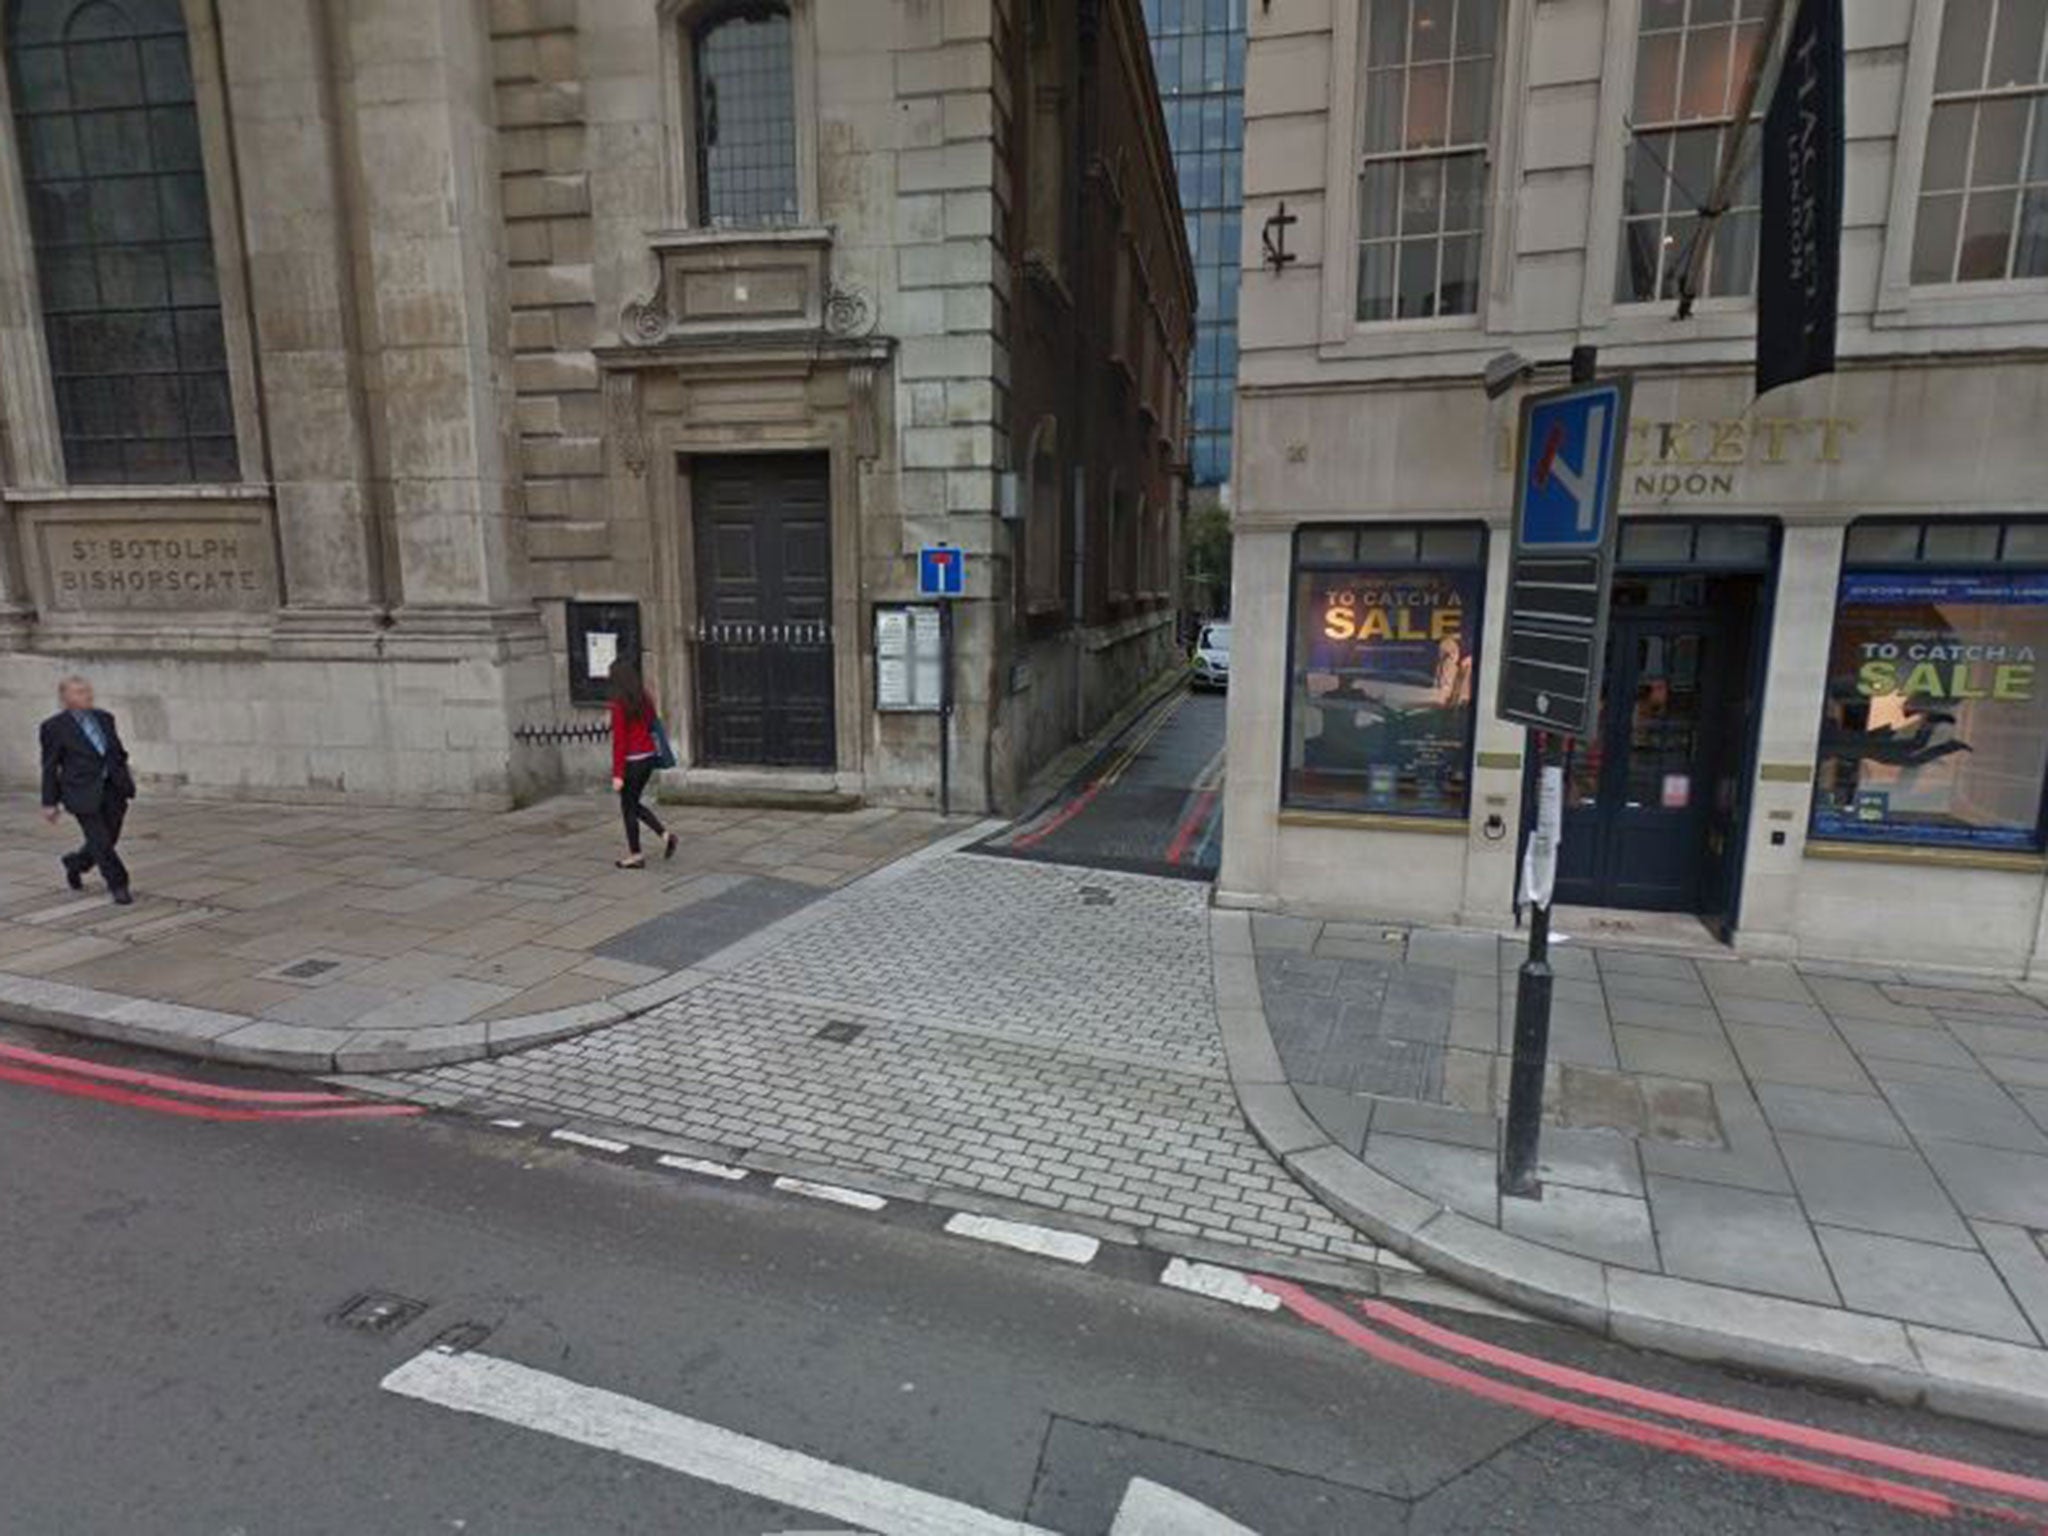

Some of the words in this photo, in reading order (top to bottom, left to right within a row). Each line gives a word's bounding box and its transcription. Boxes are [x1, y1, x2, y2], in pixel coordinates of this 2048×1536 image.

[1634, 473, 1733, 496] NDON
[109, 538, 238, 561] BOTOLPH
[61, 569, 260, 591] BISHOPSGATE
[1325, 590, 1355, 606] TO
[1363, 590, 1439, 606] CATCH
[1448, 589, 1462, 606] A
[1324, 606, 1463, 641] SALE
[1860, 642, 1899, 659] TO
[1909, 643, 2004, 662] CATCH
[2017, 645, 2036, 662] A
[1856, 660, 2036, 701] SALE
